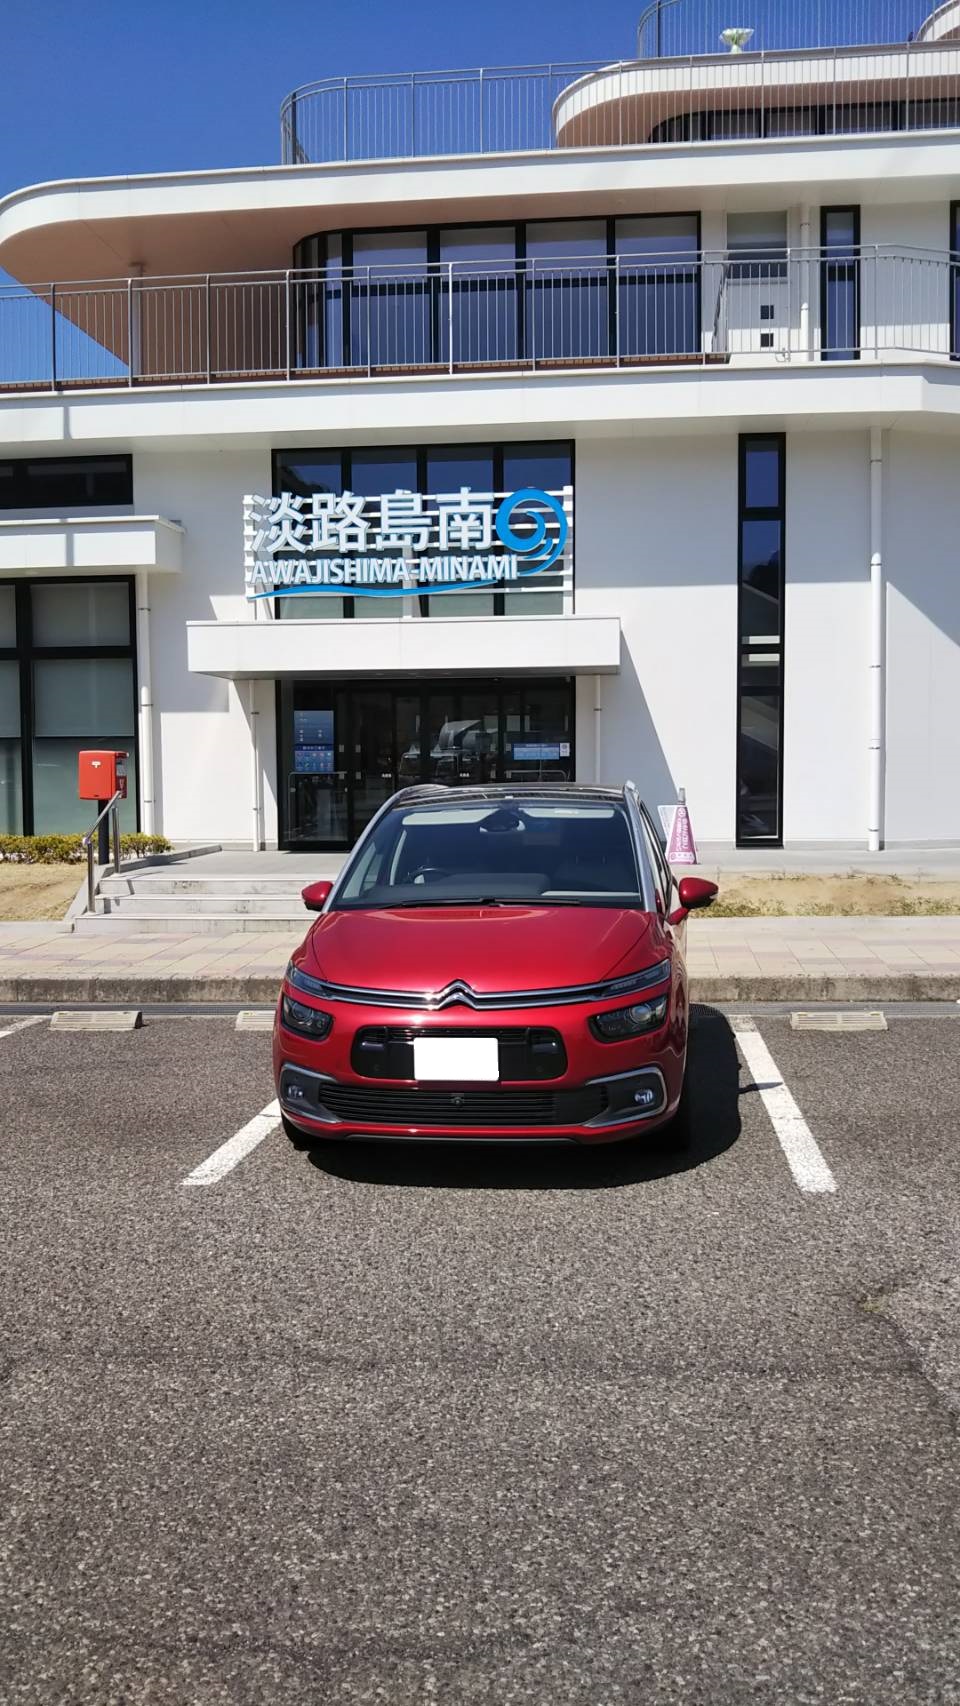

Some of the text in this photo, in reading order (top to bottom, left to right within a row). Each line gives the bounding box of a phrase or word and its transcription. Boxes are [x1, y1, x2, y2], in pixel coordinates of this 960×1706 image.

[249, 487, 495, 554] 淡路島南
[250, 554, 518, 585] AWAJISHIMA-MINAMI
